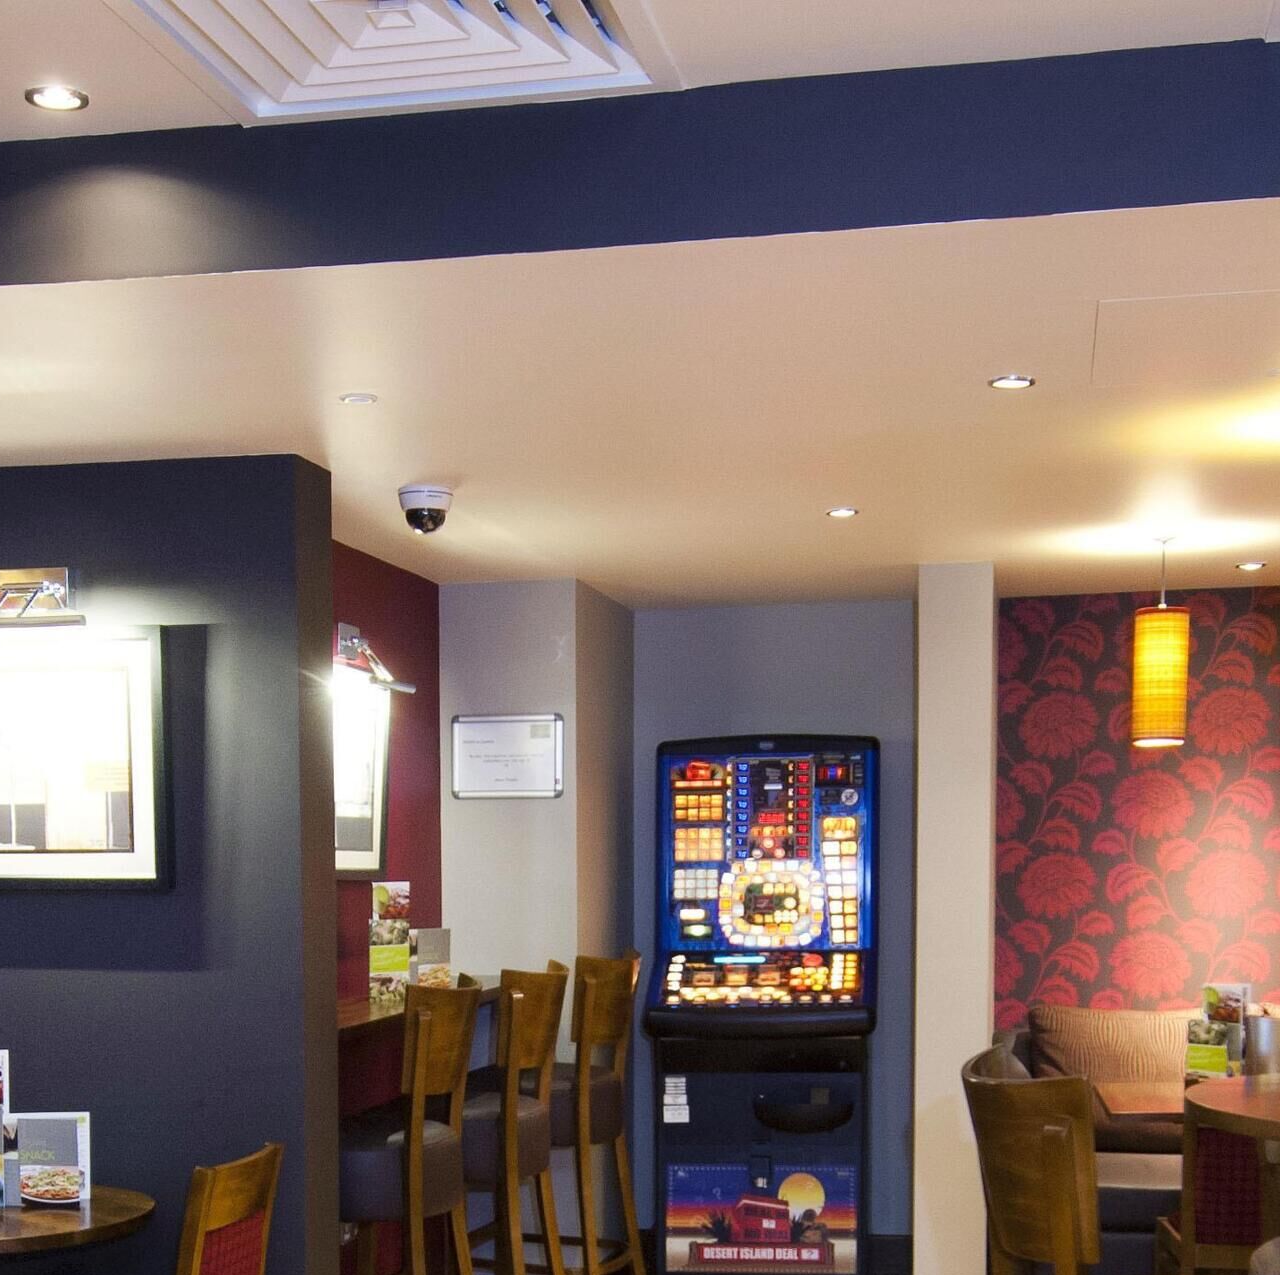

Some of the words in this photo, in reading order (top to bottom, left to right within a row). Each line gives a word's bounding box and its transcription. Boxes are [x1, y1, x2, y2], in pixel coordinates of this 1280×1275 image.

[703, 1247, 738, 1260] DESERT
[739, 1247, 774, 1260] ISLAND
[775, 1248, 798, 1260] DEAL
